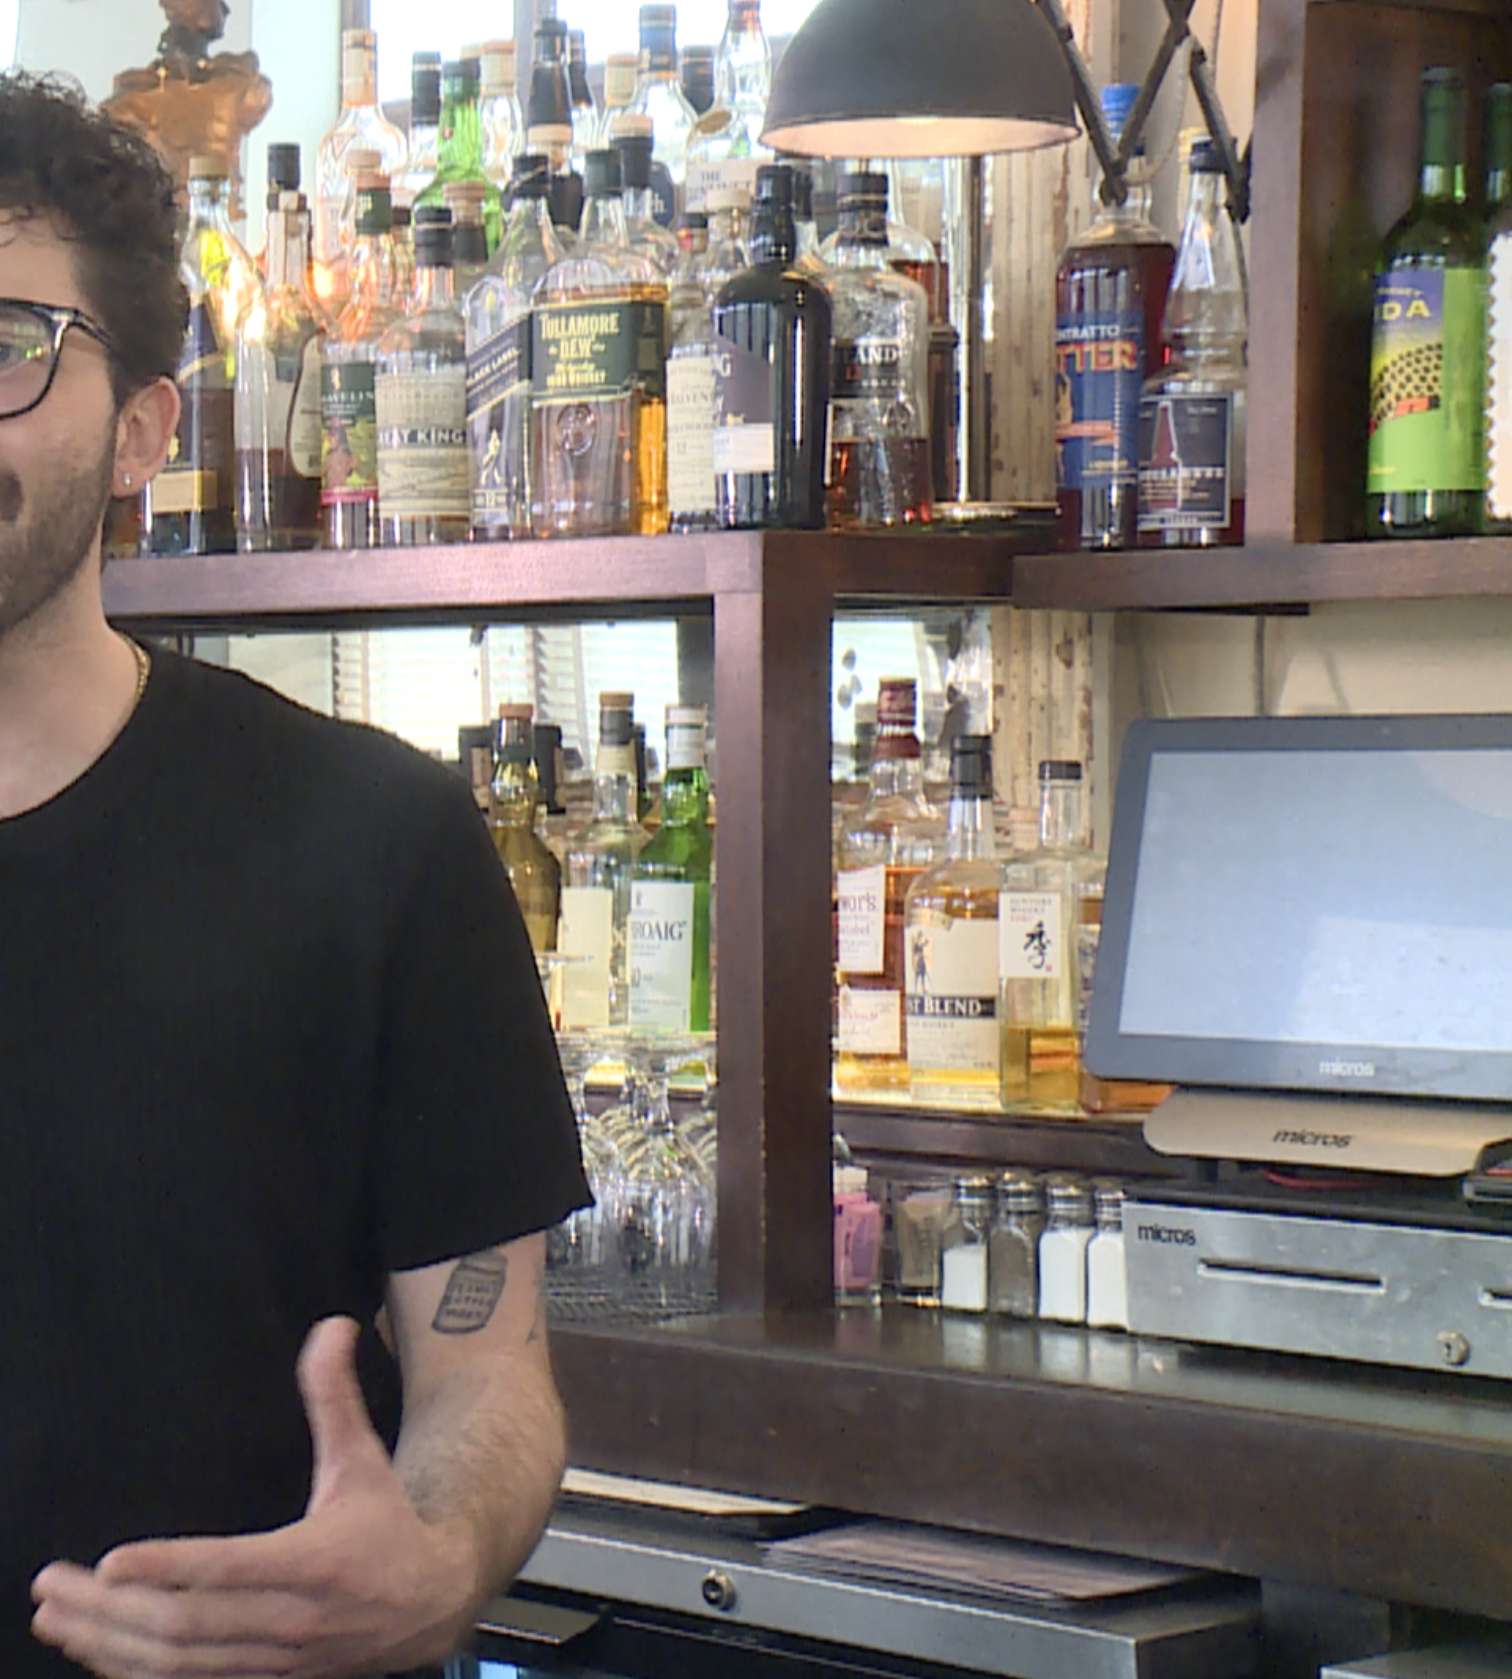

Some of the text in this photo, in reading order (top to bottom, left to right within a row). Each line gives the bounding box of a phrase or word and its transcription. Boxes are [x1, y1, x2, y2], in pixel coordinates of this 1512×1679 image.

[539, 311, 621, 341] TULLAMORE
[1056, 338, 1138, 374] TTER
[416, 427, 464, 443] KING
[924, 998, 982, 1016] BLEND
[1319, 1056, 1375, 1077] micros
[1272, 1128, 1352, 1148] micros
[1138, 1222, 1196, 1247] micros
